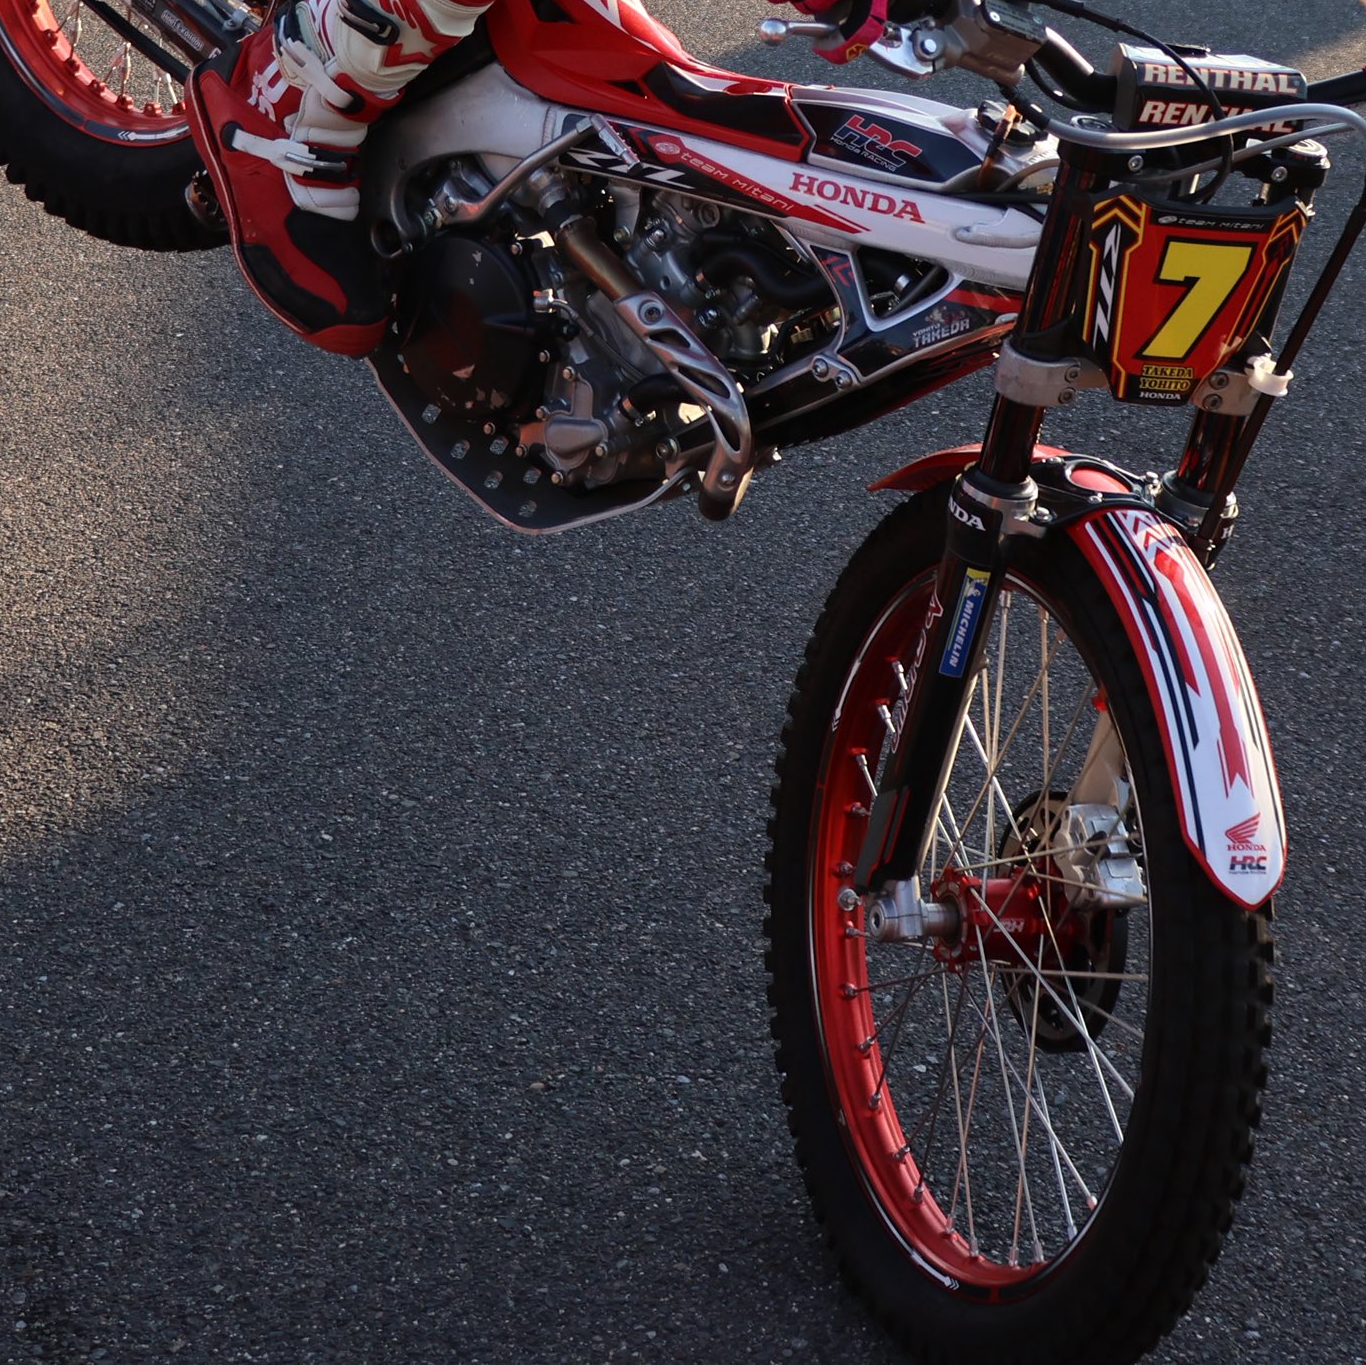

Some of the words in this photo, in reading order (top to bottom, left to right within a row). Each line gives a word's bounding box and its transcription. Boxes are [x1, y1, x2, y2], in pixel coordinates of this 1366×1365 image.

[1144, 64, 1299, 94] RENTHAL
[680, 152, 729, 180] team
[830, 137, 861, 154] Honda
[860, 150, 897, 172] RACING
[789, 172, 927, 224] HONDA
[1138, 238, 1255, 360] 7
[913, 318, 970, 348] TAKEDA
[1139, 377, 1191, 392] YOHITO
[1142, 365, 1194, 379] TAKEDA
[1139, 391, 1181, 400] HONDA
[949, 599, 974, 669] MICHELIN
[1227, 844, 1267, 852] HONDA
[1229, 855, 1268, 871] HRC
